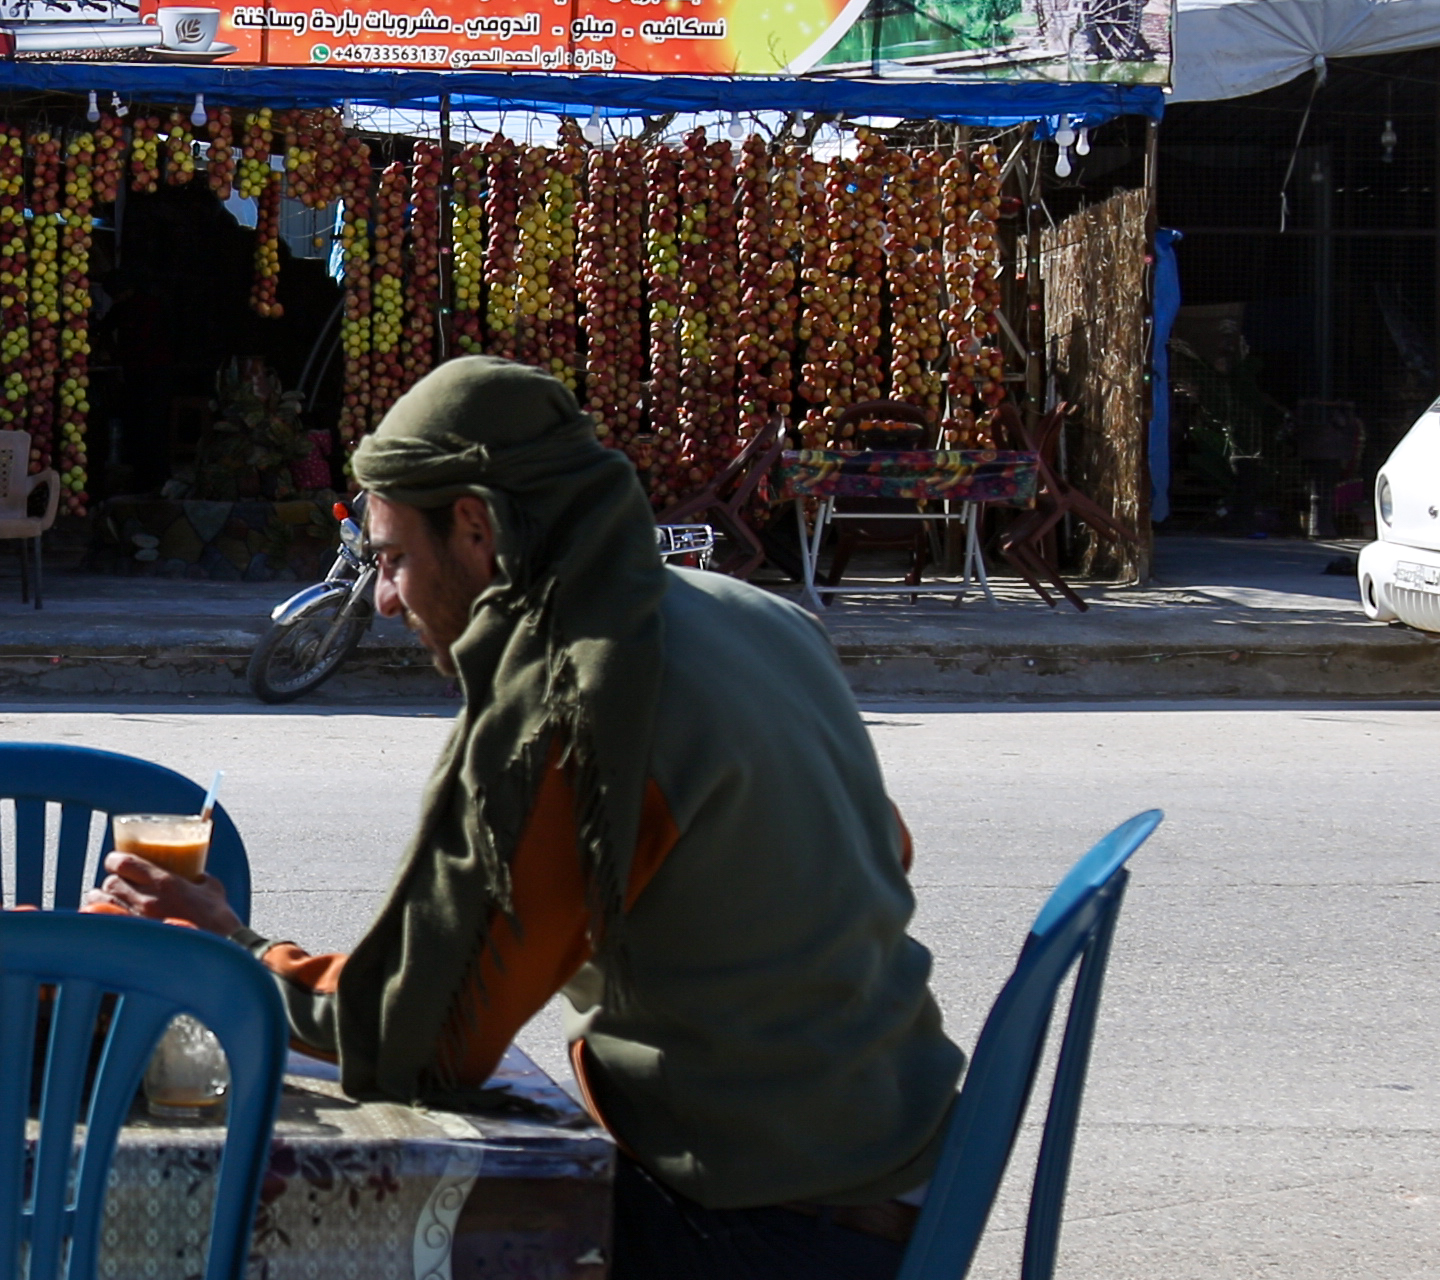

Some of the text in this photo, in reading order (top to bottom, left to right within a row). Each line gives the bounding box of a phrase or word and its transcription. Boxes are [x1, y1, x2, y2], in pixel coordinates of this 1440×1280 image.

[234, 8, 724, 40] نسكافيه ميلو اندومي مشروبات باردة وساخنة
[335, 46, 447, 62] +46733563137
[451, 50, 500, 67] الحموي
